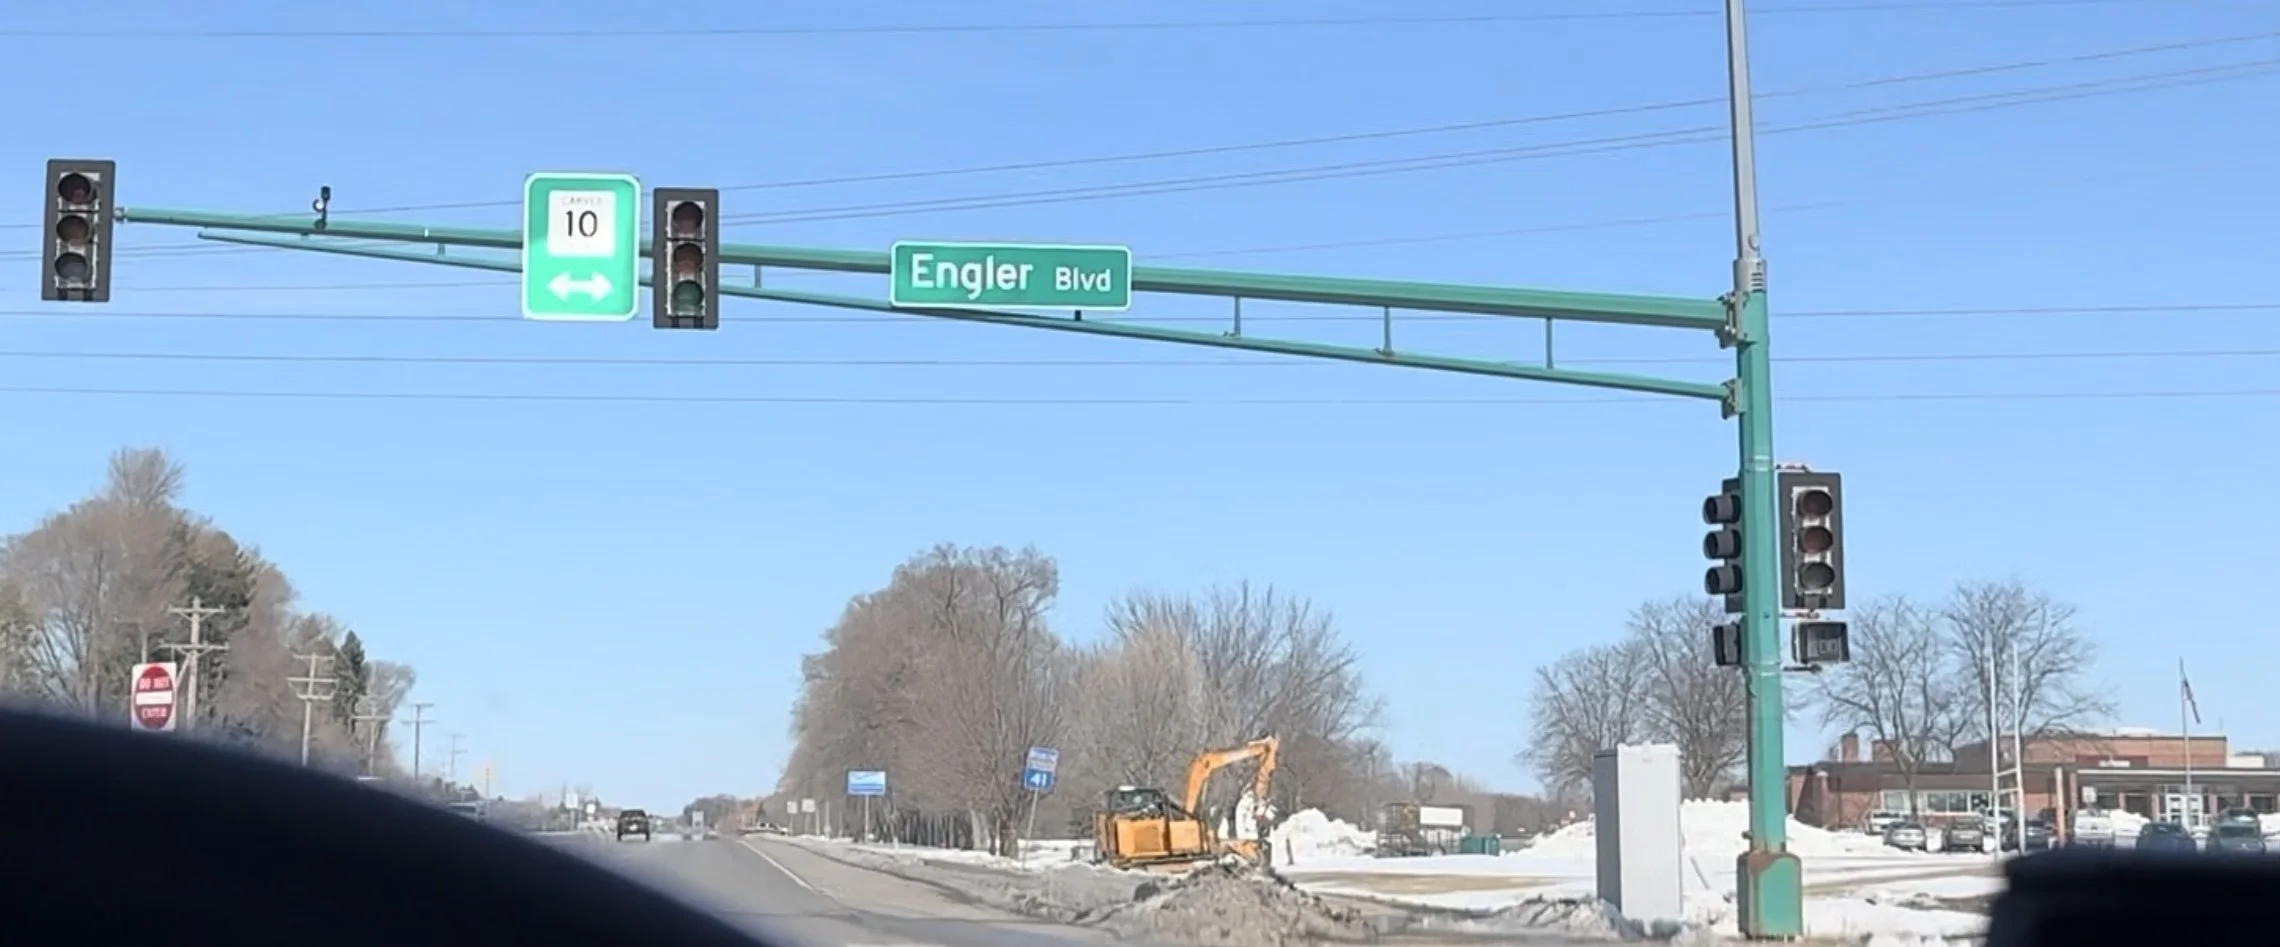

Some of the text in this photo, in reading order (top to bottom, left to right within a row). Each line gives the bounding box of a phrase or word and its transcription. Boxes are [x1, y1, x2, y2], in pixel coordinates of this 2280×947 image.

[565, 210, 598, 237] 10
[911, 253, 1112, 300] Engler Blvd
[1030, 773, 1048, 787] 41
